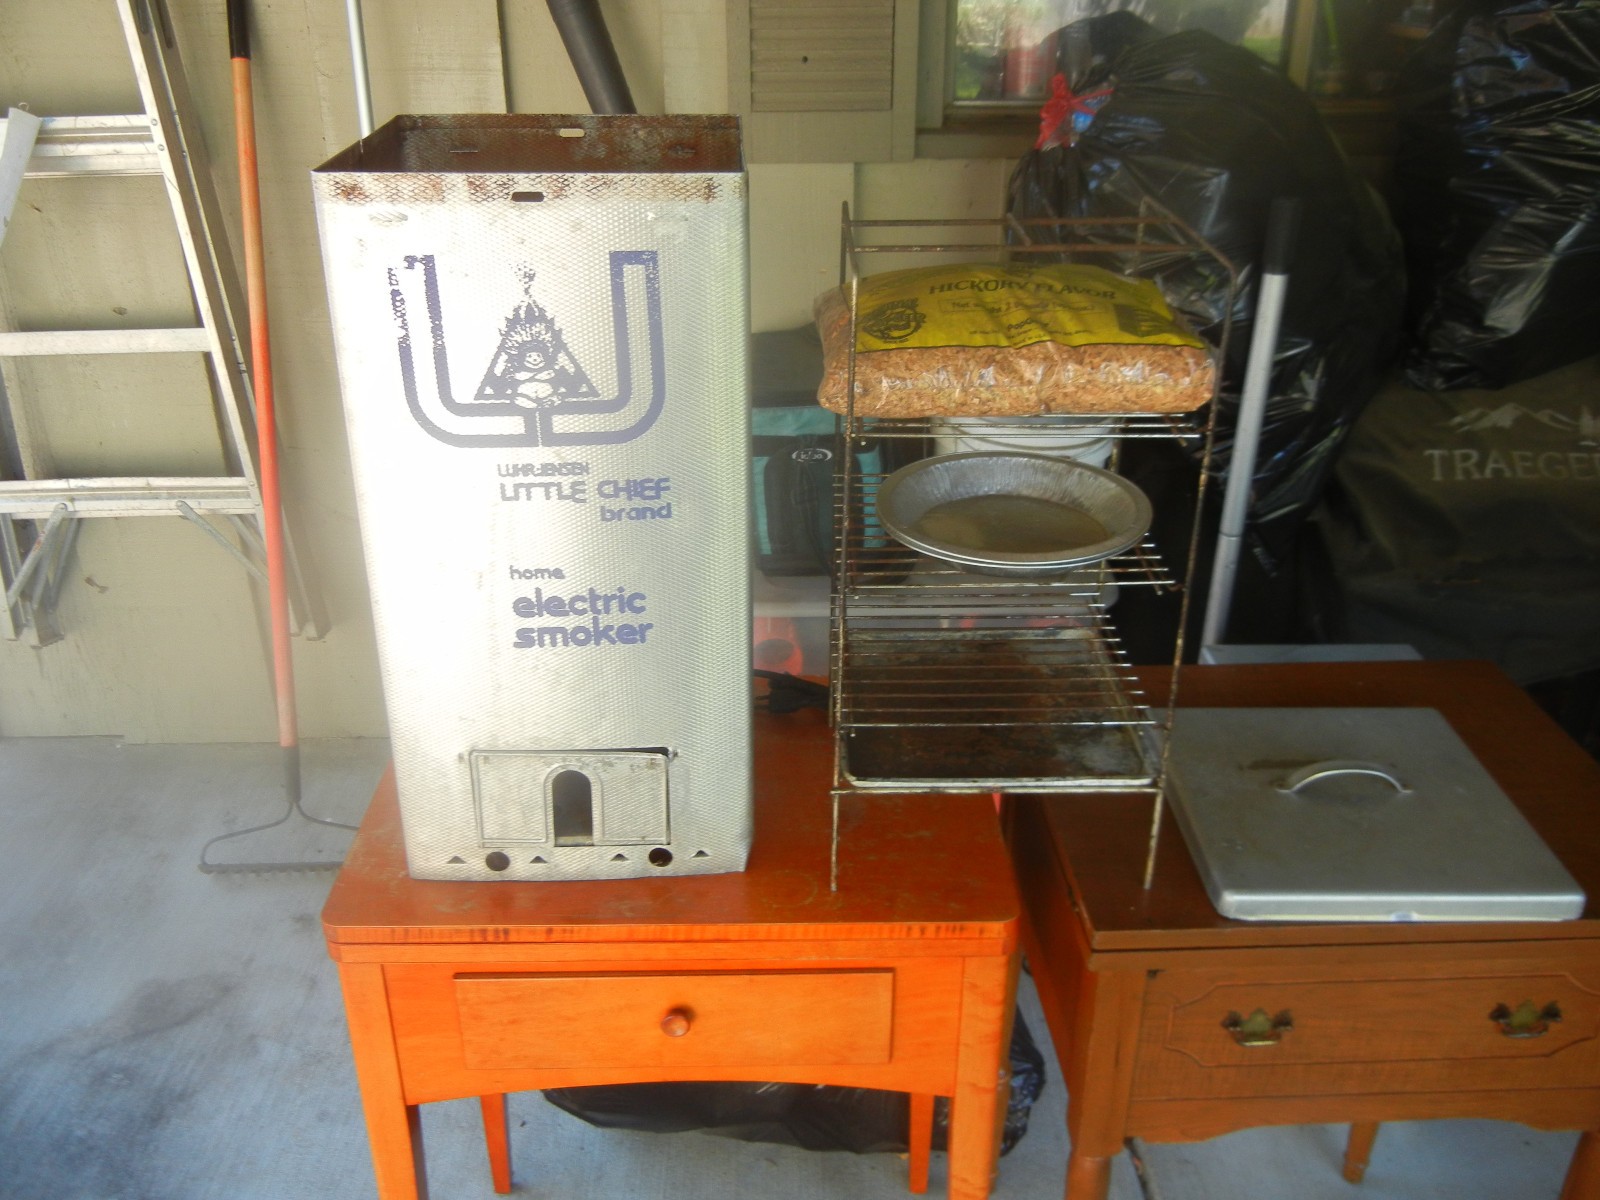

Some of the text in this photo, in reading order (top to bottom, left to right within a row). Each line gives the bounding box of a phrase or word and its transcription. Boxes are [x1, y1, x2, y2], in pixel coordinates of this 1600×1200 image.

[928, 279, 1117, 299] HICKORY FLAVOR
[1423, 448, 1600, 481] TRAEGE
[500, 477, 671, 503] LITTLE CHIEF
[600, 502, 672, 522] brand
[509, 564, 566, 580] home
[512, 586, 647, 618] electric
[513, 615, 654, 648] smoker
